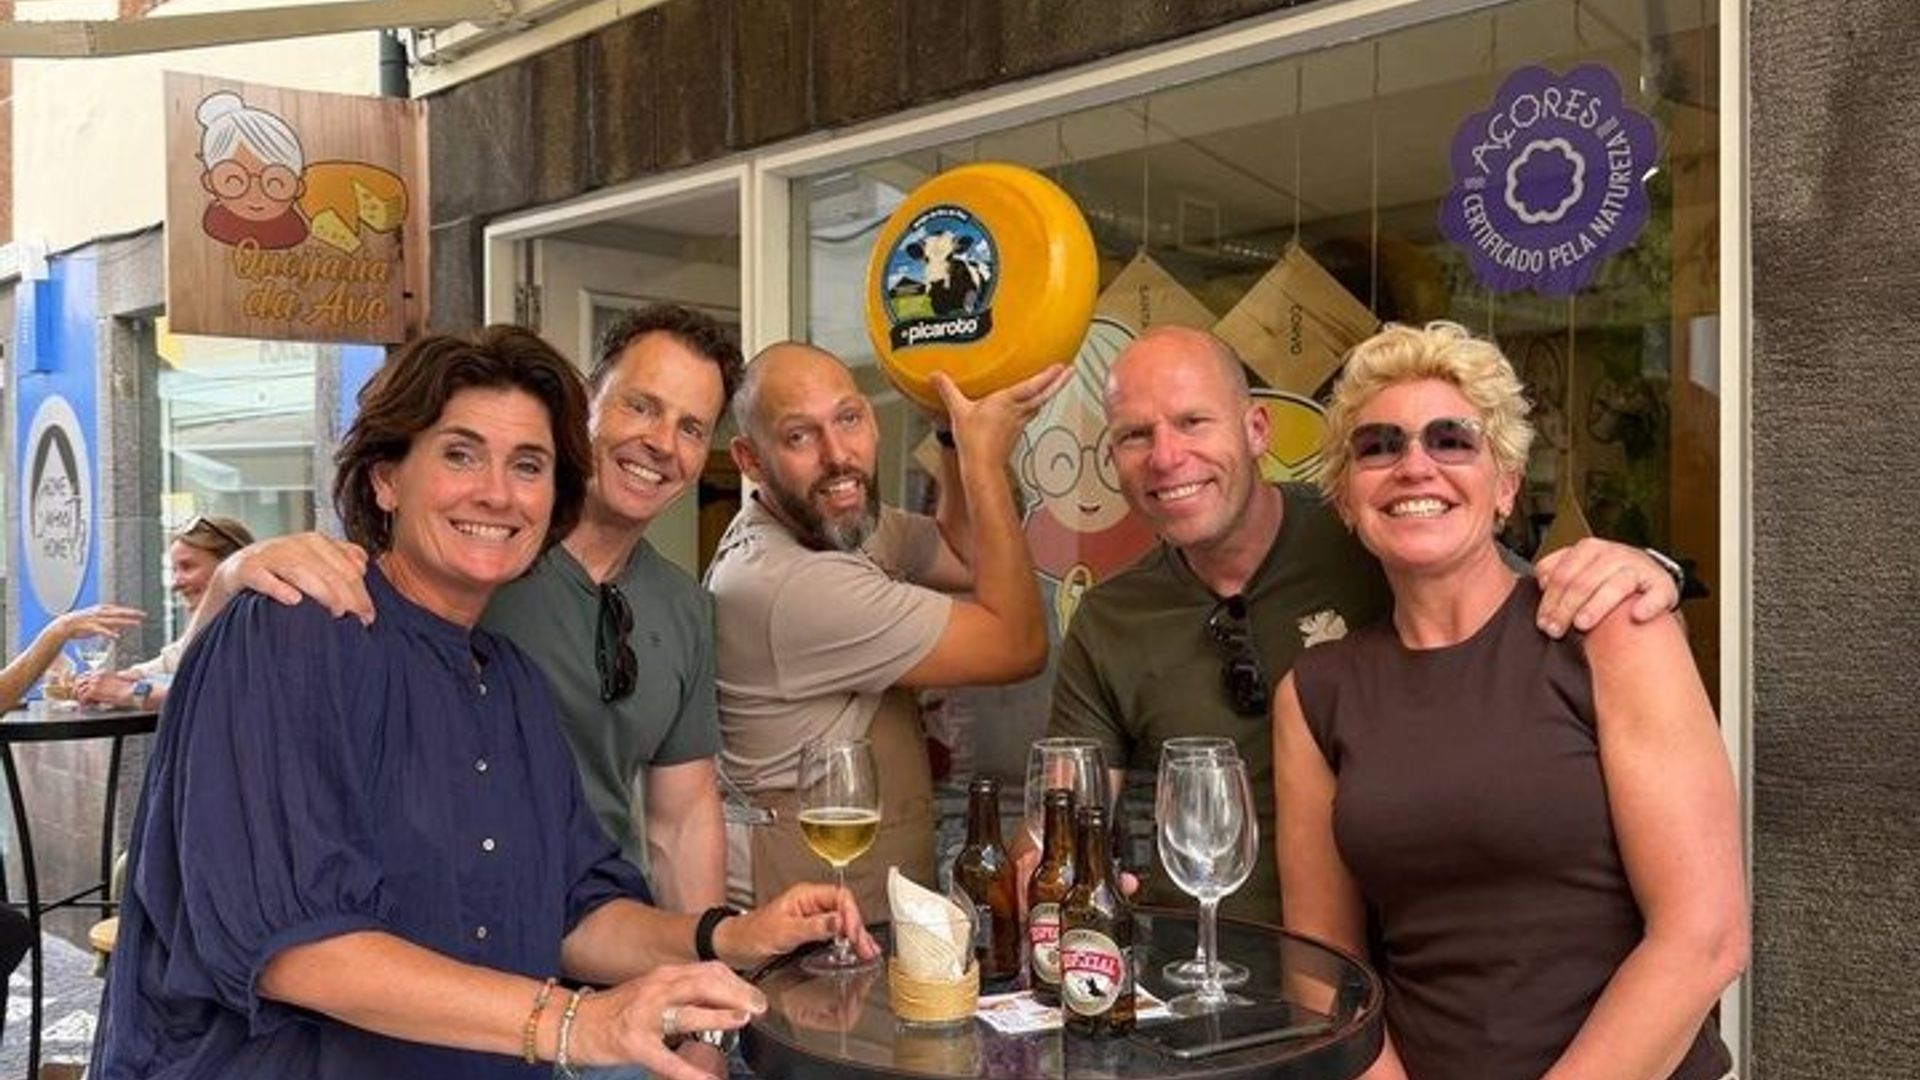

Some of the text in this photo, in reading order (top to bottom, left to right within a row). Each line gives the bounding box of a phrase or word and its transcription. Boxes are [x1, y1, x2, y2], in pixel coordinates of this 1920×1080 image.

[1472, 87, 1601, 173] AÇORES
[1463, 129, 1633, 274] CERTIFICADO PELA NATUREZA
[244, 277, 299, 319] da
